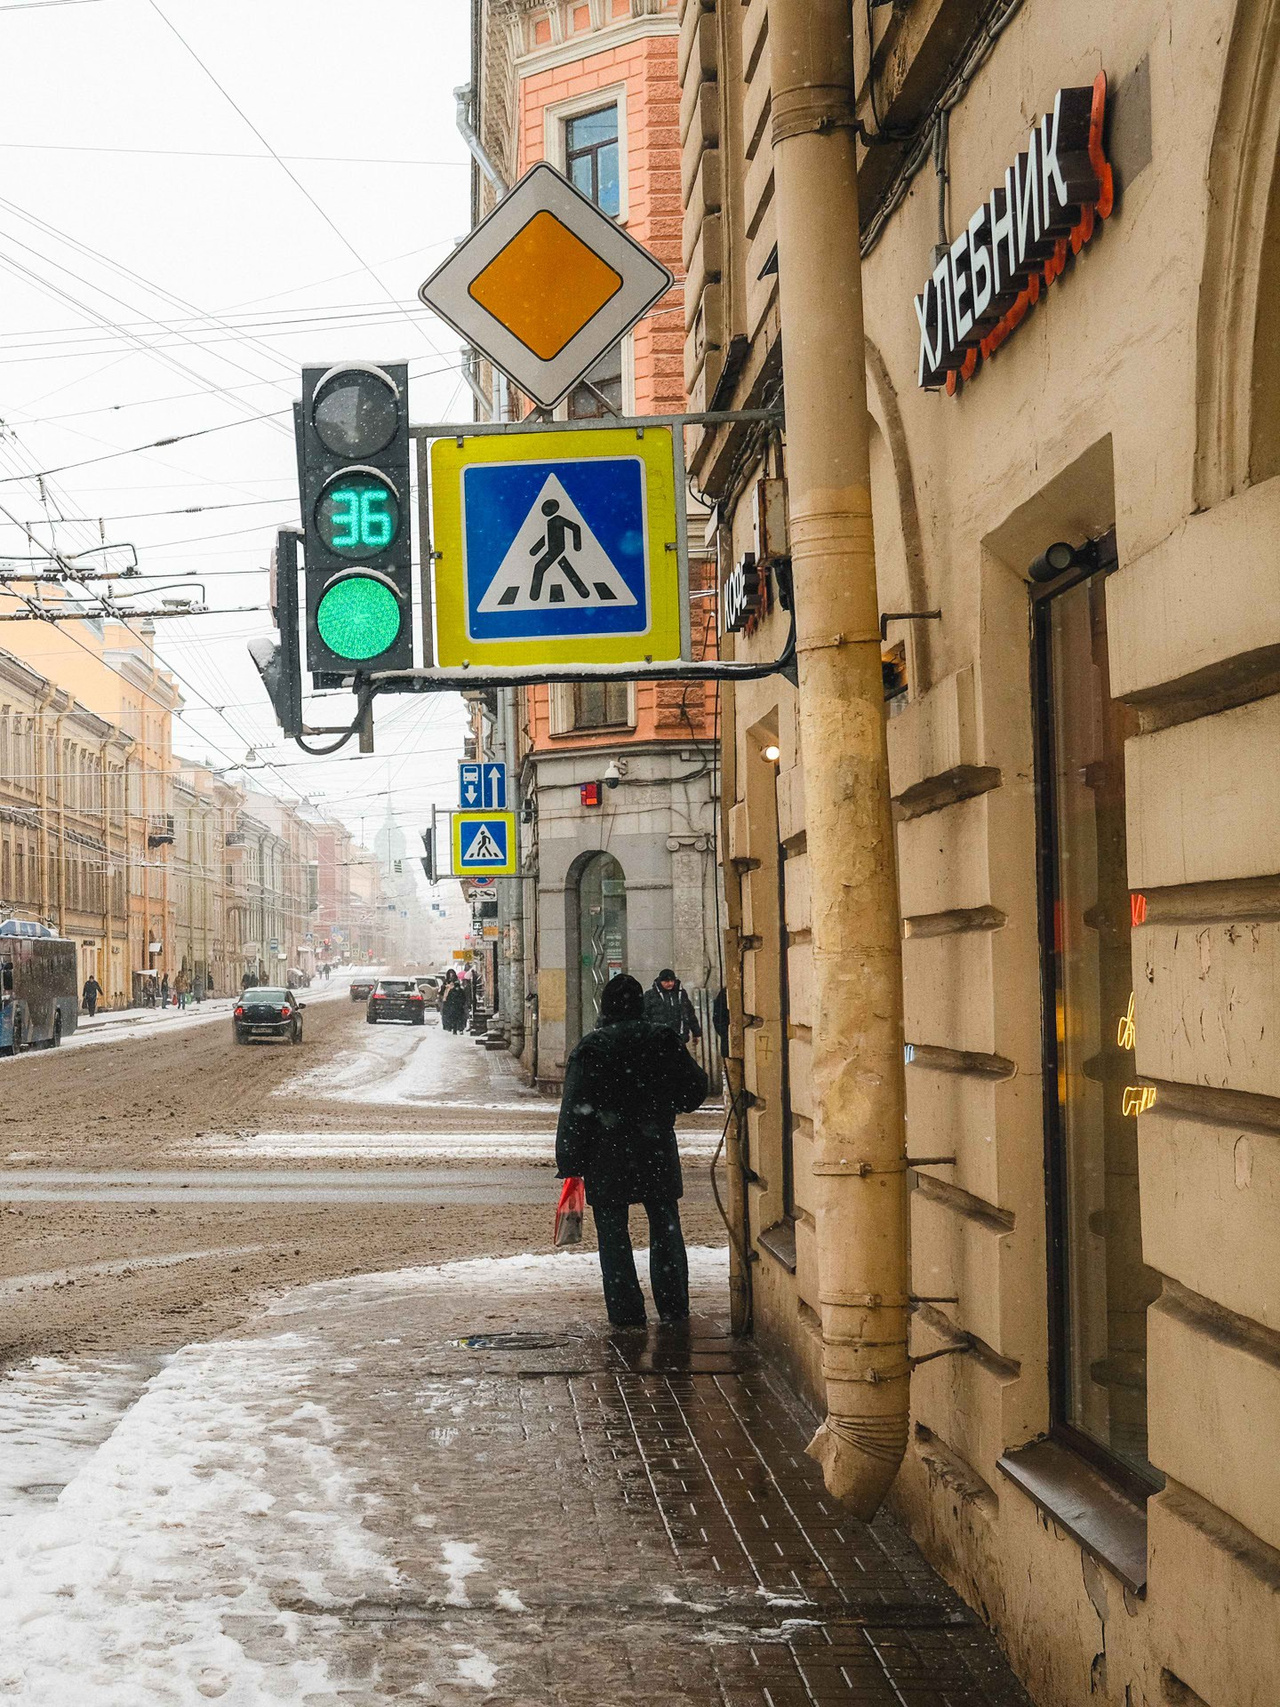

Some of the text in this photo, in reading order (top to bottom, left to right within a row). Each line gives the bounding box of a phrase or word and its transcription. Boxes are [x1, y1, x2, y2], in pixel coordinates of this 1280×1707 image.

[913, 87, 1068, 388] ХЛЕБНИК
[331, 489, 392, 547] 36
[724, 553, 748, 633] КОФЕ
